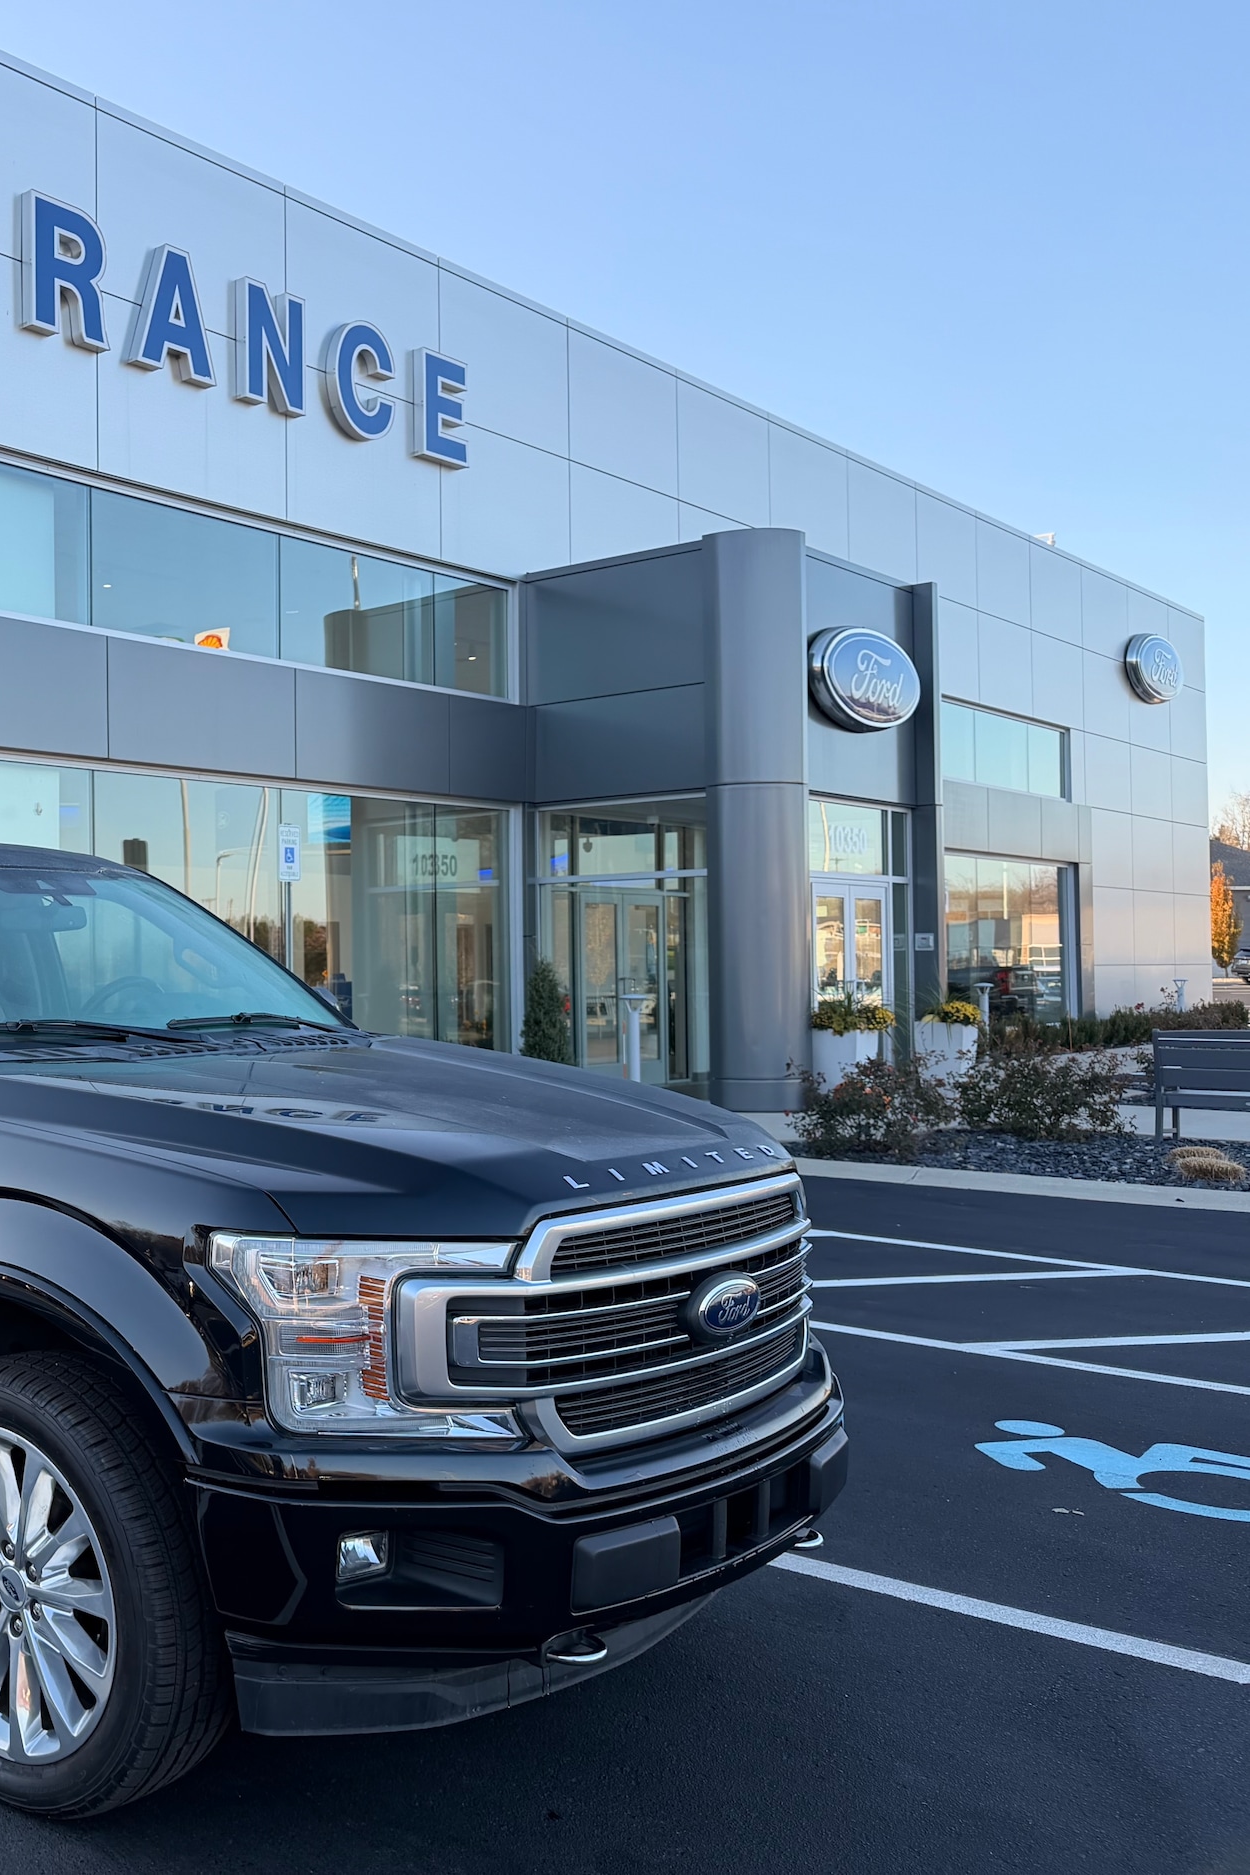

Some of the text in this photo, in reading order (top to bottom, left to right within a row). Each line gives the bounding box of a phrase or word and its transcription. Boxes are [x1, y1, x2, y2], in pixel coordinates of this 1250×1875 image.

[851, 649, 904, 707] Ford
[1151, 648, 1178, 688] Ford
[829, 824, 867, 855] 10350
[563, 1144, 775, 1190] LIMITED
[718, 1291, 751, 1325] Ford
